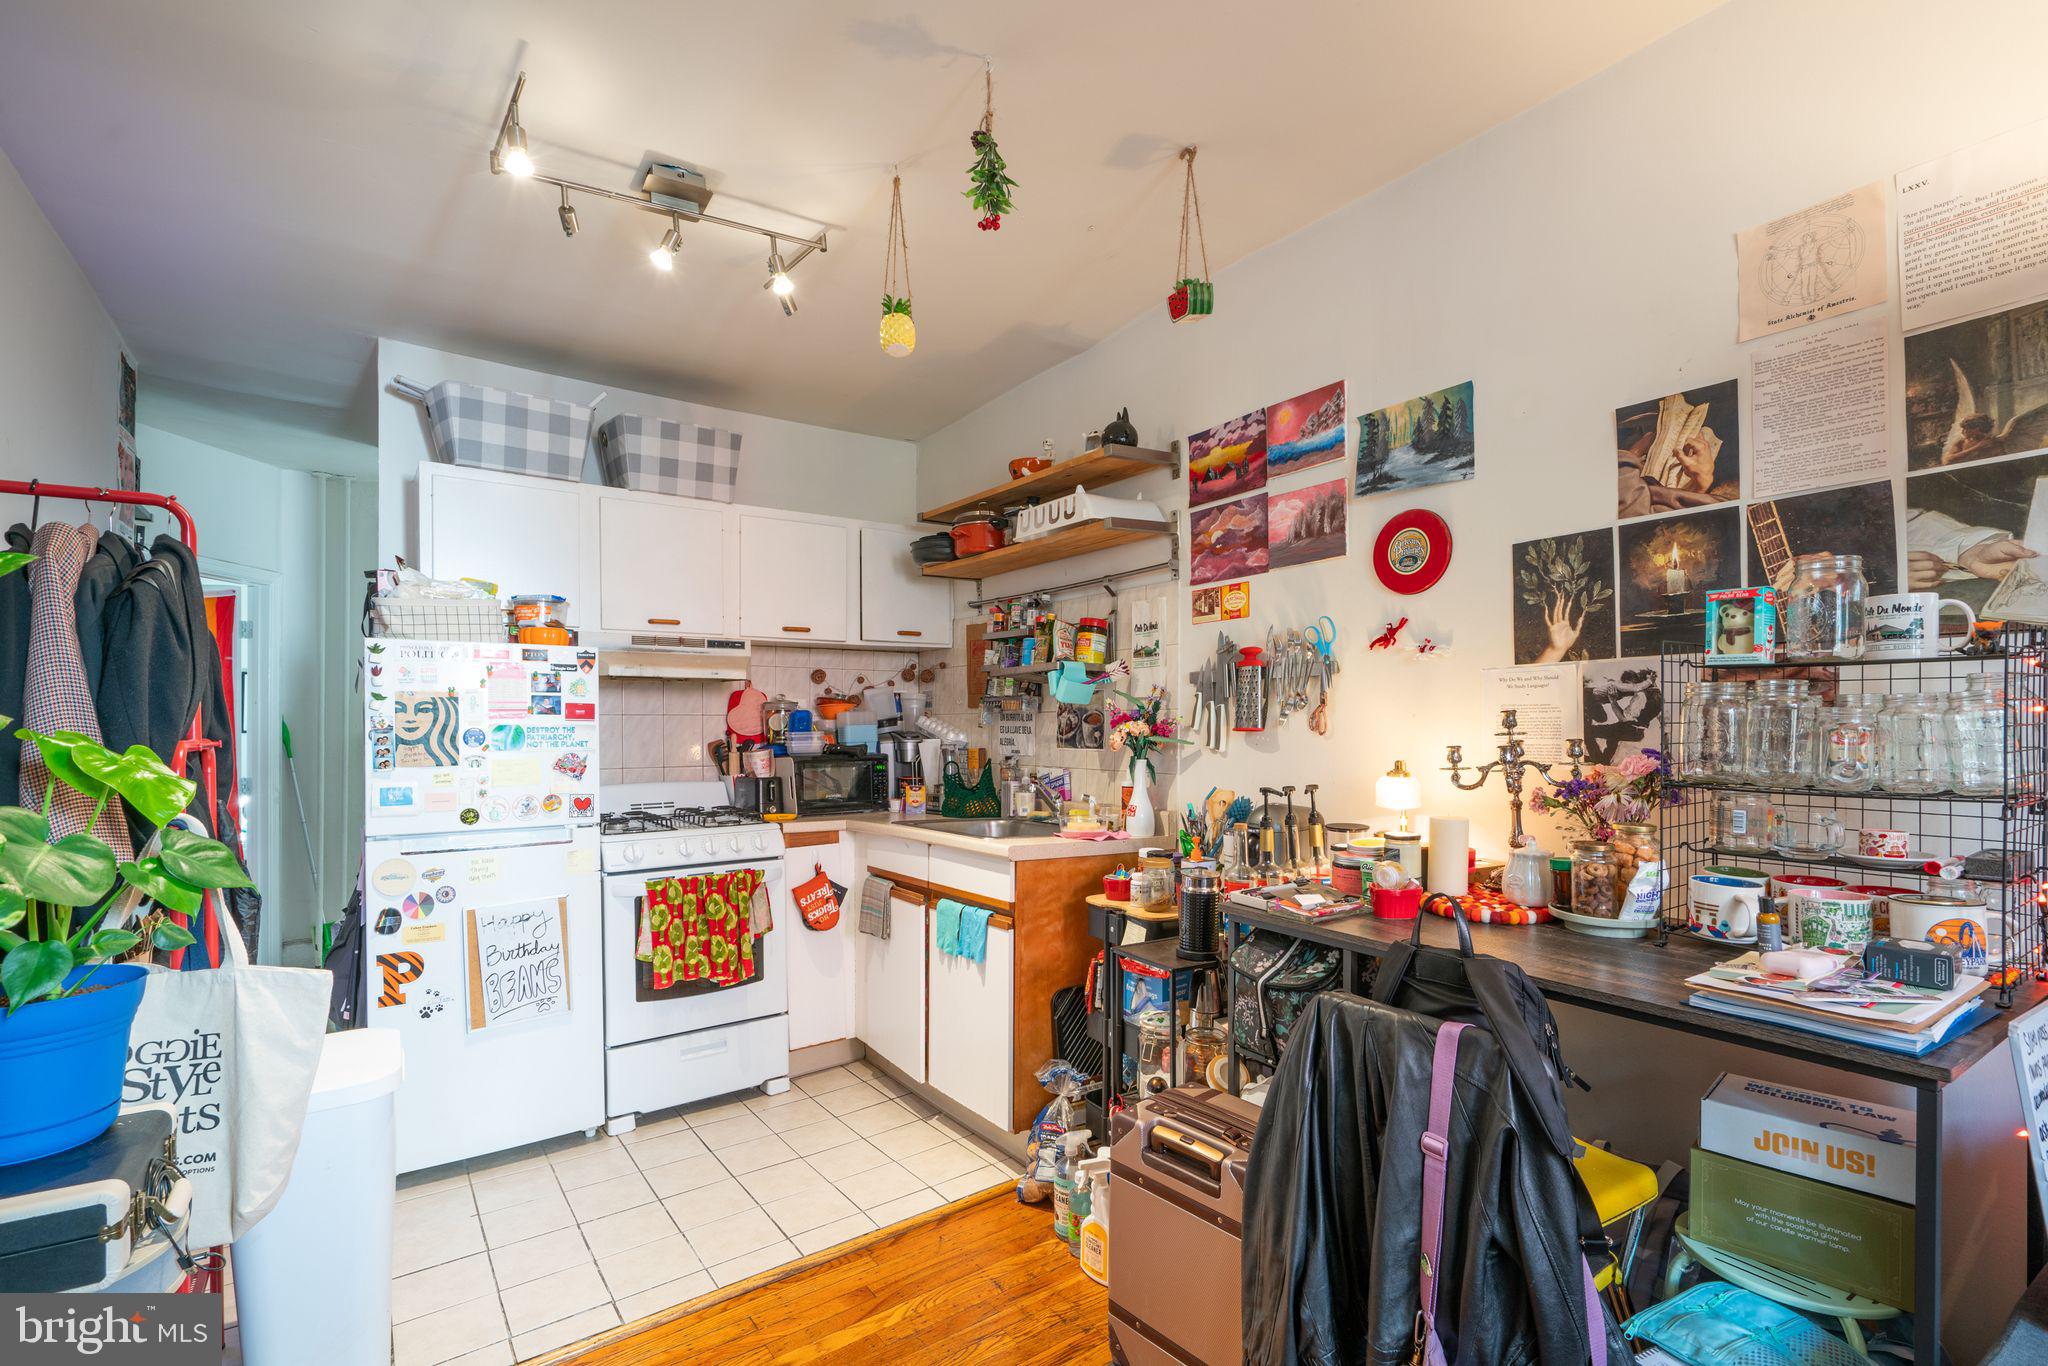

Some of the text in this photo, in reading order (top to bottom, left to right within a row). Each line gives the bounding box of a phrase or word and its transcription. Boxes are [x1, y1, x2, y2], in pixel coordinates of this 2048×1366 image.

[1926, 228, 1957, 243] beautiful
[1959, 216, 1993, 232] moments
[1995, 211, 2008, 220] life
[2009, 205, 2029, 217] gives
[1938, 239, 1948, 247] the
[1950, 229, 1978, 243] difficult
[1905, 264, 1917, 272] and
[1924, 258, 1937, 266] will
[1939, 252, 1959, 262] never
[1960, 241, 1992, 255] convince
[1995, 232, 2019, 245] myself
[2022, 226, 2037, 236] that
[1934, 243, 1960, 256] growth.
[1980, 233, 1988, 241] all
[1944, 256, 1968, 268] cannot
[2002, 237, 2028, 250] cannot
[2030, 233, 2040, 242] be
[1905, 286, 1924, 295] cover
[1933, 280, 1942, 288] up
[1954, 269, 1976, 281] numb
[1987, 263, 1997, 271] So
[2033, 249, 2046, 258] not
[1918, 289, 1938, 300] open,
[1939, 284, 1953, 293] and
[1994, 266, 2013, 277] have
[2022, 260, 2036, 270] any
[1932, 270, 1949, 280] want
[1961, 262, 1974, 271] feel
[1984, 256, 1993, 264] all
[1817, 304, 1825, 312] of
[800, 883, 834, 907] TREATS
[808, 900, 839, 921] TRICKS
[481, 910, 554, 939] Happy
[486, 940, 560, 967] Birthday
[376, 951, 424, 1008] P
[485, 958, 562, 1014] BEANS
[1744, 1086, 1898, 1122] COLUMBIA LAW
[1746, 1082, 1874, 1113] WELCOME TO
[1754, 1130, 1876, 1179] JOIN US!
[1734, 1198, 1862, 1242] May your moments be illuminated
[1754, 1211, 1840, 1242] with the soothing glow
[1770, 1222, 1796, 1236] candle
[1798, 1232, 1827, 1245] warmer
